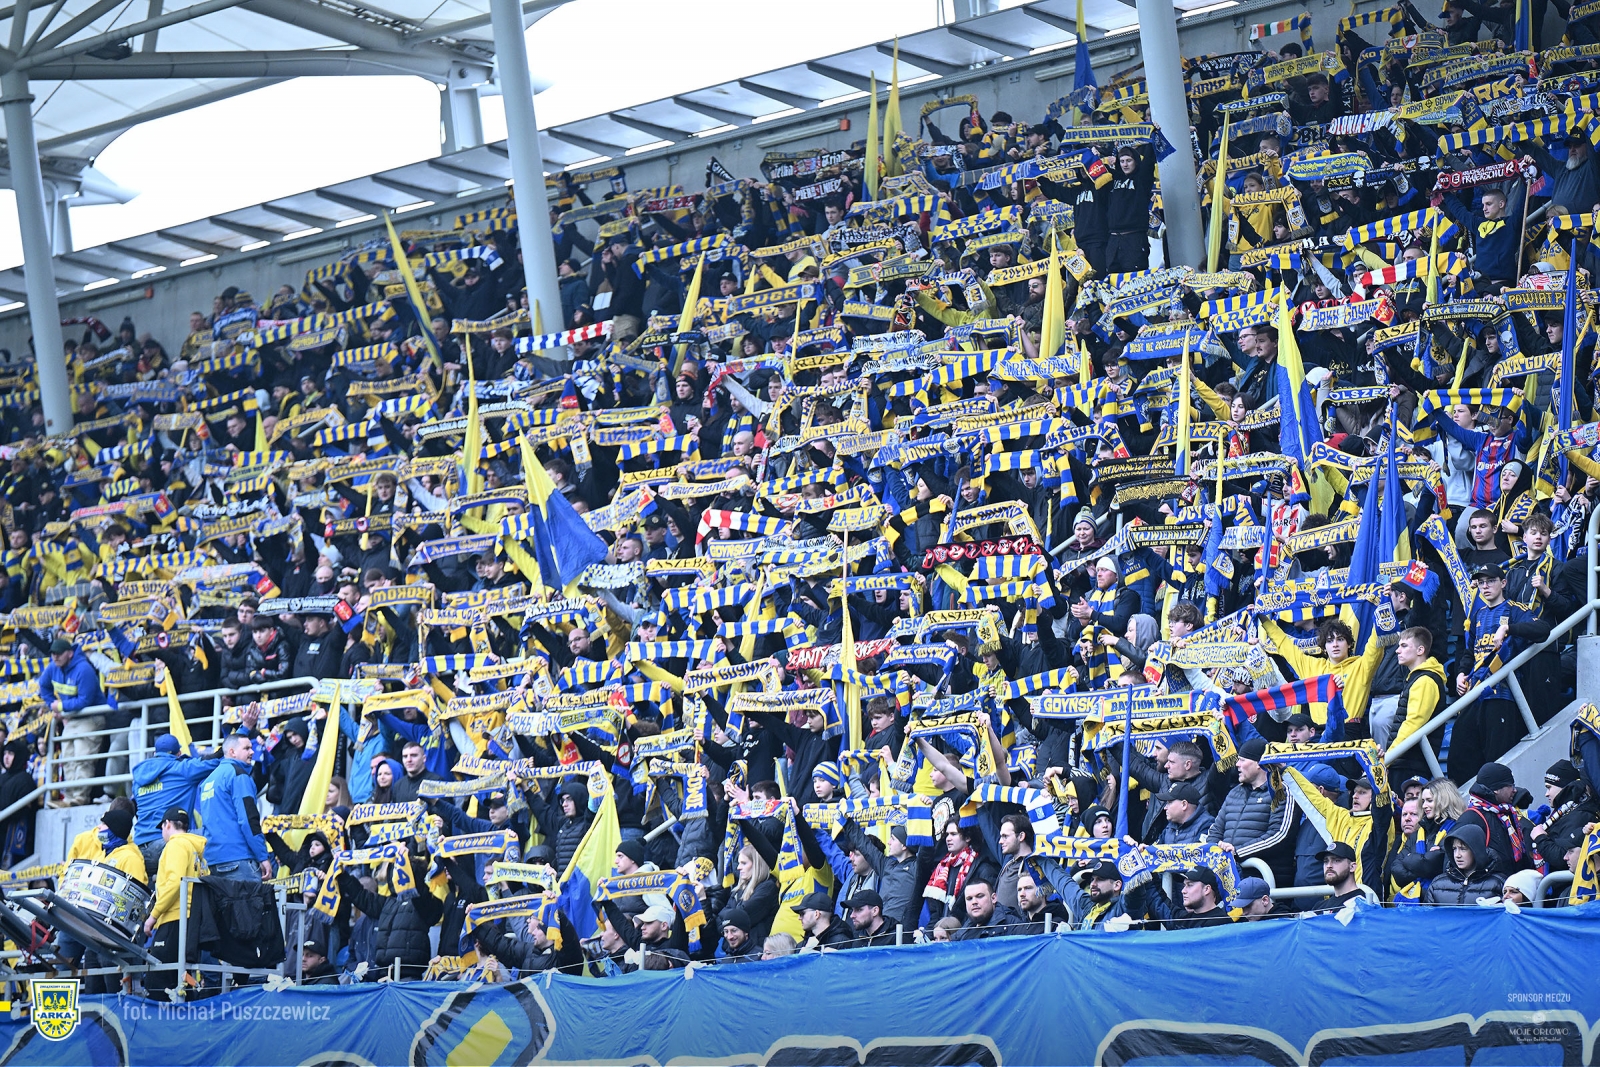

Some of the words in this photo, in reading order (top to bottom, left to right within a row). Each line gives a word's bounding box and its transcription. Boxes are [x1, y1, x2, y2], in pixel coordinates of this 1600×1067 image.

[1092, 128, 1118, 138] ARKA
[1155, 697, 1183, 709] REDA
[1036, 834, 1120, 860] ARKA
